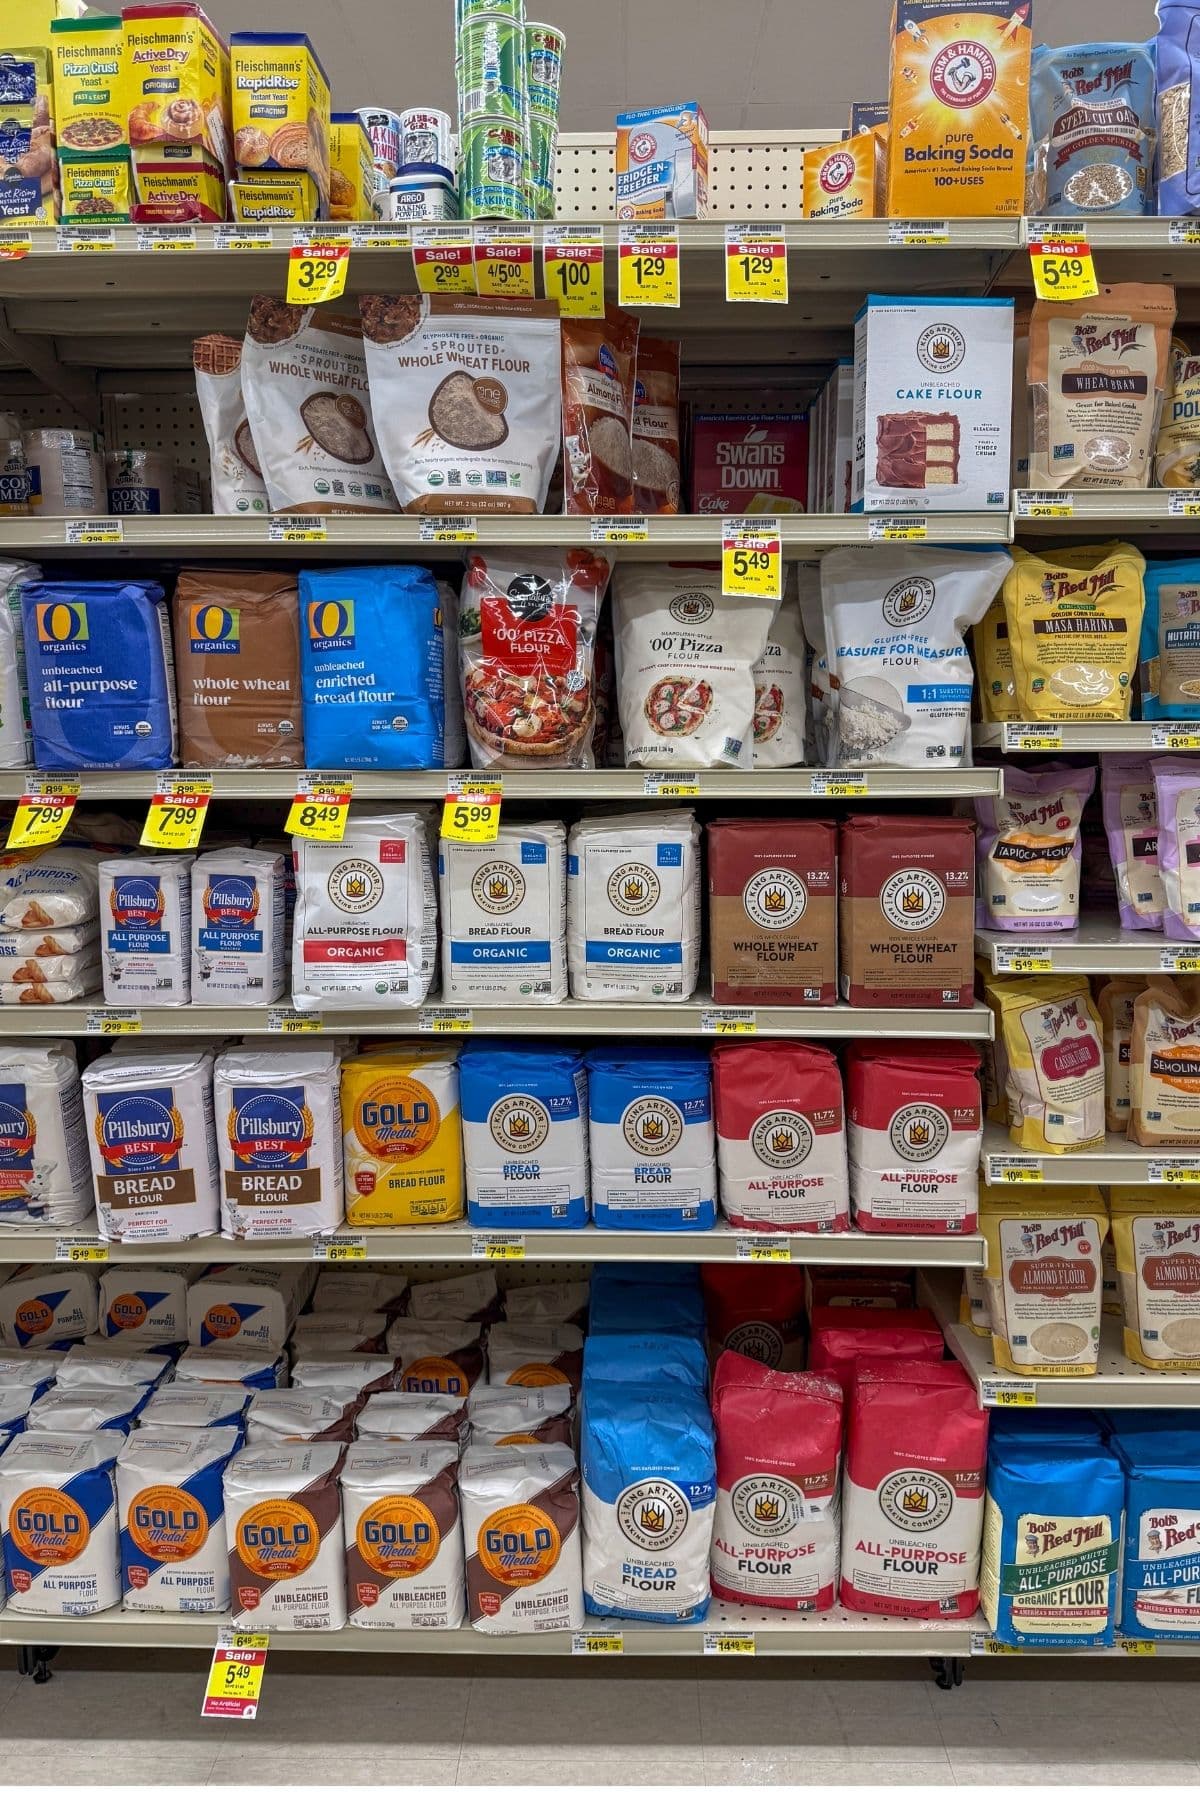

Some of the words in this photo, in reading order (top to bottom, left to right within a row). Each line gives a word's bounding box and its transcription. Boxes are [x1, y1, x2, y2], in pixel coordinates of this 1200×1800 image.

[128, 31, 193, 46] Fleischmann's
[57, 44, 121, 58] Fleischmann's
[64, 62, 88, 74] Pizza
[90, 62, 118, 74] Crust
[150, 63, 171, 72] Yeast
[236, 60, 301, 72] Fleischmann's
[933, 55, 947, 81] ARM
[948, 49, 956, 58] &
[958, 45, 992, 80] HAMMER
[81, 77, 102, 86] Yeast
[237, 76, 299, 89] RapidRise
[1075, 72, 1103, 95] Red
[1104, 61, 1133, 92] Mill
[145, 81, 177, 91] ORIGINAL
[251, 107, 286, 116] FAST-ACTING
[1061, 110, 1090, 131] STEEL
[1093, 113, 1112, 124] CUT
[945, 132, 973, 145] pure
[904, 147, 966, 163] Baking
[969, 145, 1013, 160] Soda
[618, 174, 659, 195] FREEZER
[2, 205, 29, 215] Yeast
[395, 210, 427, 218] POWDER
[397, 204, 426, 212] BAKING
[302, 248, 338, 257] Sale!
[631, 246, 667, 254] Sale!
[1041, 244, 1079, 254] Sale!
[426, 251, 460, 260] Sale!
[432, 341, 499, 354] SPROUTED
[399, 355, 443, 368] WHOLE
[446, 351, 488, 372] WHEAT
[492, 357, 529, 372] FLOUR
[1077, 378, 1109, 389] WHEAT
[1112, 379, 1135, 390] BRAN
[897, 389, 934, 399] CAKE
[938, 389, 982, 399] FLOUR
[716, 442, 784, 464] Swans
[112, 491, 150, 501] CORN
[113, 501, 150, 511] MEAL
[699, 497, 729, 511] Cake
[1046, 621, 1072, 632] MASA
[1076, 620, 1114, 631] HARINA
[313, 638, 351, 648] organics
[525, 631, 565, 645] PIZZA
[874, 634, 928, 644] GLUTEN-FREE
[43, 642, 87, 653] organics
[194, 642, 236, 651] organics
[511, 645, 550, 654] FLOUR
[683, 638, 723, 653] Pizza
[890, 644, 914, 654] FOR
[882, 658, 919, 666] FLOUR
[42, 665, 102, 675] unbleached
[43, 678, 138, 693] all-purpose
[193, 677, 239, 690] whole
[243, 678, 290, 690] wheat
[316, 673, 375, 688] enriched
[194, 693, 231, 706] flour
[315, 690, 356, 704] bread
[358, 688, 395, 703] flour
[922, 689, 934, 699] 1:1
[46, 695, 84, 709] flour
[31, 795, 66, 804] Sale!
[1000, 847, 1037, 859] TAPIOCA
[806, 872, 829, 880] 13.2%
[749, 876, 766, 896] KING
[769, 873, 801, 897] ARTHUR
[119, 895, 157, 909] Pillsbury
[128, 909, 146, 918] BEST
[307, 927, 370, 936] ALL-PURPOSE
[373, 927, 403, 935] FLOUR
[469, 927, 498, 935] BREAD
[501, 927, 531, 935] FLOUR
[112, 934, 127, 942] ALL
[129, 933, 166, 942] PURPOSE
[327, 947, 384, 957] ORGANIC
[734, 943, 774, 951] WHOLE
[778, 943, 818, 951] WHEAT
[757, 953, 794, 961] FLOUR
[549, 1096, 572, 1106] 12.7%
[361, 1102, 430, 1127] GOLD
[109, 1121, 170, 1141] Pillsbury
[377, 1127, 418, 1141] Medal
[125, 1142, 156, 1154] BEST
[503, 1165, 540, 1174] BREAD
[389, 1177, 414, 1188] BREAD
[417, 1175, 445, 1186] FLOUR
[504, 1171, 540, 1181] FLOUR
[114, 1176, 175, 1195] BREAD
[129, 1193, 163, 1204] FLOUR
[1023, 1271, 1057, 1284] ALMOND
[1059, 1270, 1086, 1283] FLOUR
[19, 1309, 49, 1322] GOLD
[955, 1472, 980, 1482] 11.7%
[624, 1491, 645, 1512] KING
[647, 1486, 683, 1516] ARTHUR
[18, 1508, 79, 1533] GOLD
[1027, 1521, 1056, 1533] Bob's
[29, 1532, 66, 1545] Medal
[244, 1524, 309, 1547] GOLD
[1042, 1531, 1072, 1554] Red
[1073, 1521, 1104, 1547] Mill
[889, 1538, 938, 1548] UNBLEACHED
[258, 1547, 297, 1560] Medal
[855, 1540, 967, 1564] ALL-PURPOSE
[883, 1559, 938, 1575] FLOUR
[1019, 1559, 1077, 1575] UNBLEACHED
[1080, 1549, 1108, 1562] WHITE
[622, 1564, 677, 1578] BREAD
[1019, 1559, 1106, 1591] ALL-PURPOSE
[44, 1579, 56, 1588] ALL
[58, 1579, 97, 1590] PURPOSE
[622, 1576, 675, 1591] FLOUR
[275, 1592, 328, 1603] UNBLEACHED
[1018, 1592, 1057, 1605] ORGANIC
[1059, 1580, 1105, 1605] FLOUR
[225, 1651, 256, 1660] Sale!
